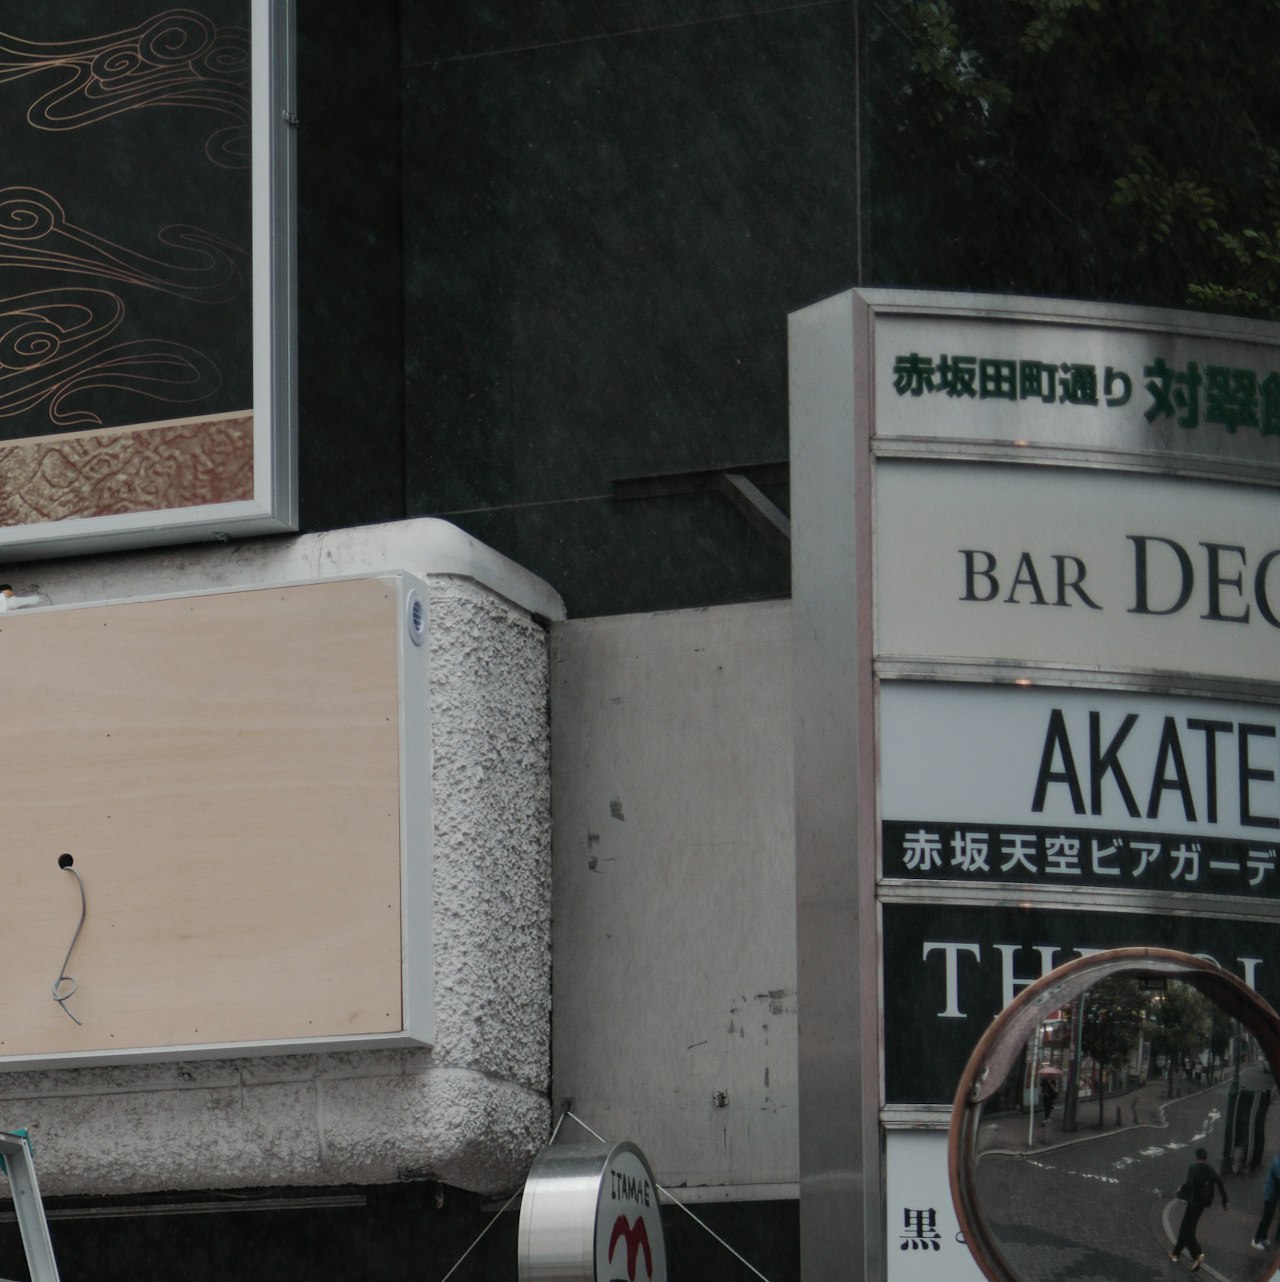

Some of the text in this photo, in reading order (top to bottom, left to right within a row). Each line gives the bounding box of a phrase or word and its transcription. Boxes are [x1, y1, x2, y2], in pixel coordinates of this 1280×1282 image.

[893, 351, 1133, 407] 赤坂田町通り
[958, 549, 1103, 611] BAR
[1031, 708, 1280, 829] AKATE
[902, 828, 1278, 887] 赤坂天空ビアガーデ
[922, 941, 1100, 1019] TH
[610, 1169, 650, 1208] ITAMAE
